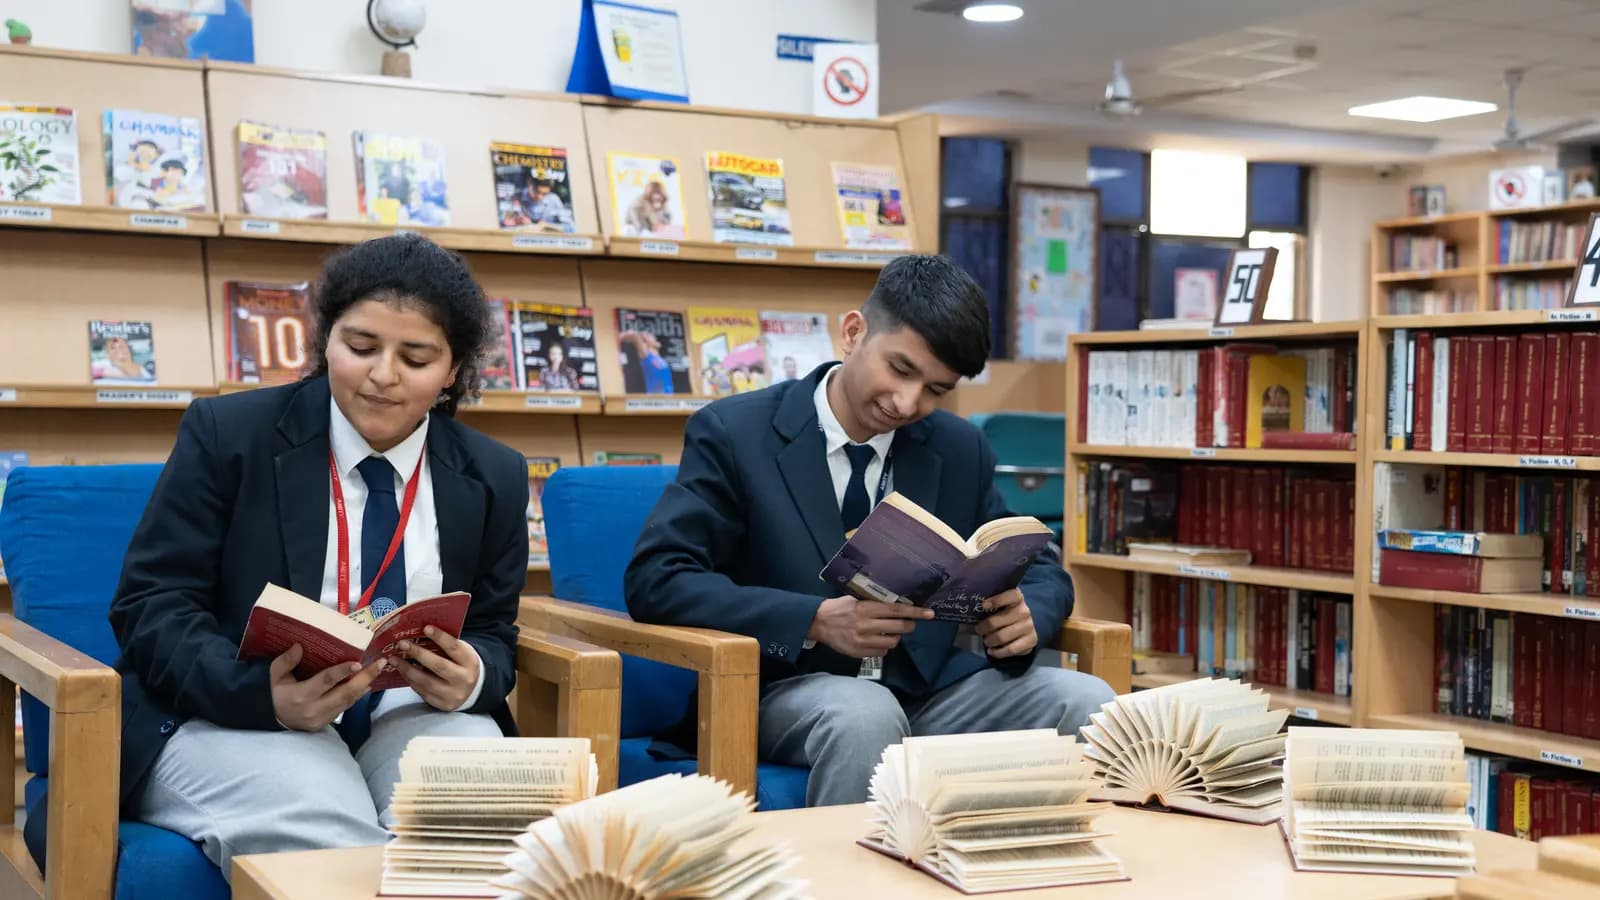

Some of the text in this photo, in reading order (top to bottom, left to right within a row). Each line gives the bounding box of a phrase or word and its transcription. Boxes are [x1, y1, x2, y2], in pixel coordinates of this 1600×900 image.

[707, 154, 780, 173] AUTOCAR
[1560, 312, 1581, 320] Fiction
[619, 309, 683, 337] health
[249, 315, 306, 368] 10
[1574, 608, 1596, 617] Fiction
[393, 626, 421, 639] THE
[1550, 753, 1572, 763] Fiction
